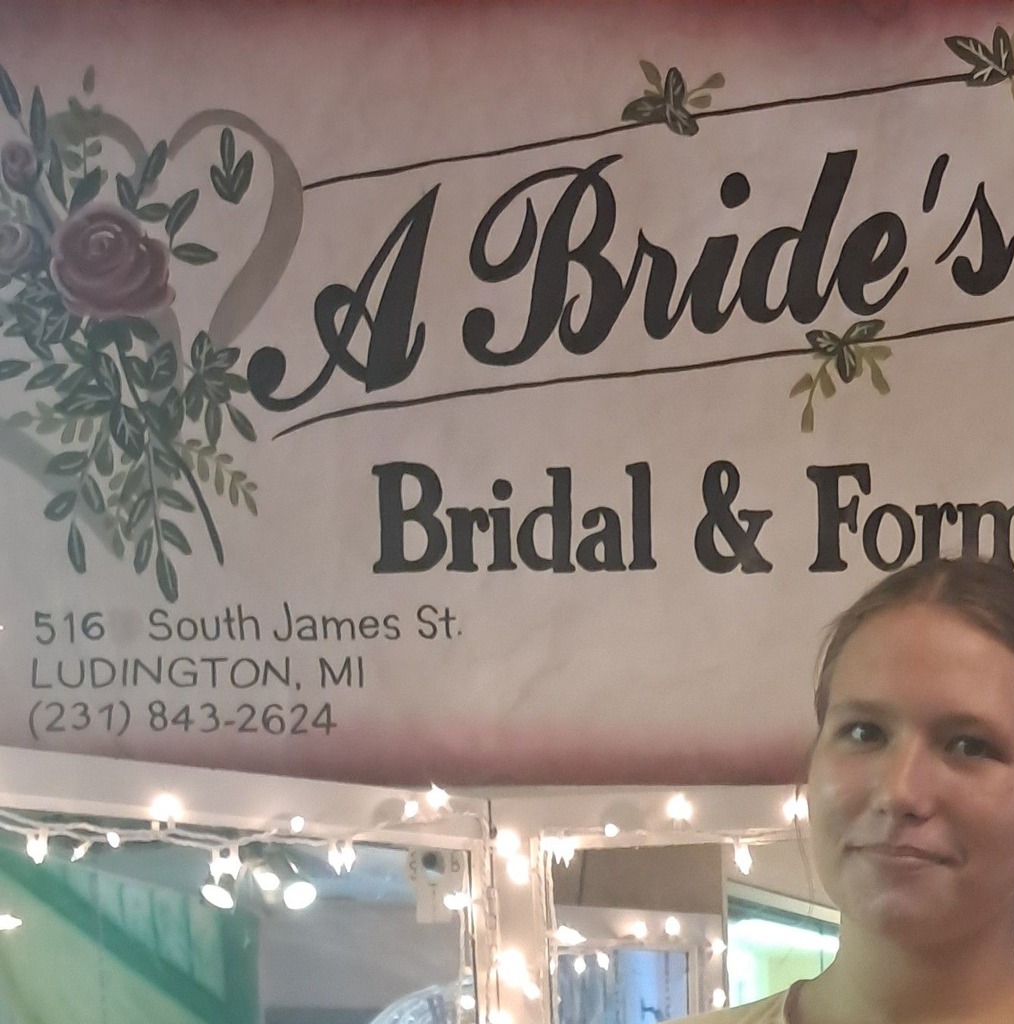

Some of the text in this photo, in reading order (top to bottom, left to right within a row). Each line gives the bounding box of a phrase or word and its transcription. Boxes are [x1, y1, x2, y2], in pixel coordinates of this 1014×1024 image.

[247, 182, 441, 412] A
[372, 462, 657, 574] Bridal
[694, 460, 773, 575] &
[34, 602, 463, 645] 516 South James St.
[31, 655, 365, 690] LUDINGTON, MI
[28, 700, 338, 741] (231) 843-2624
